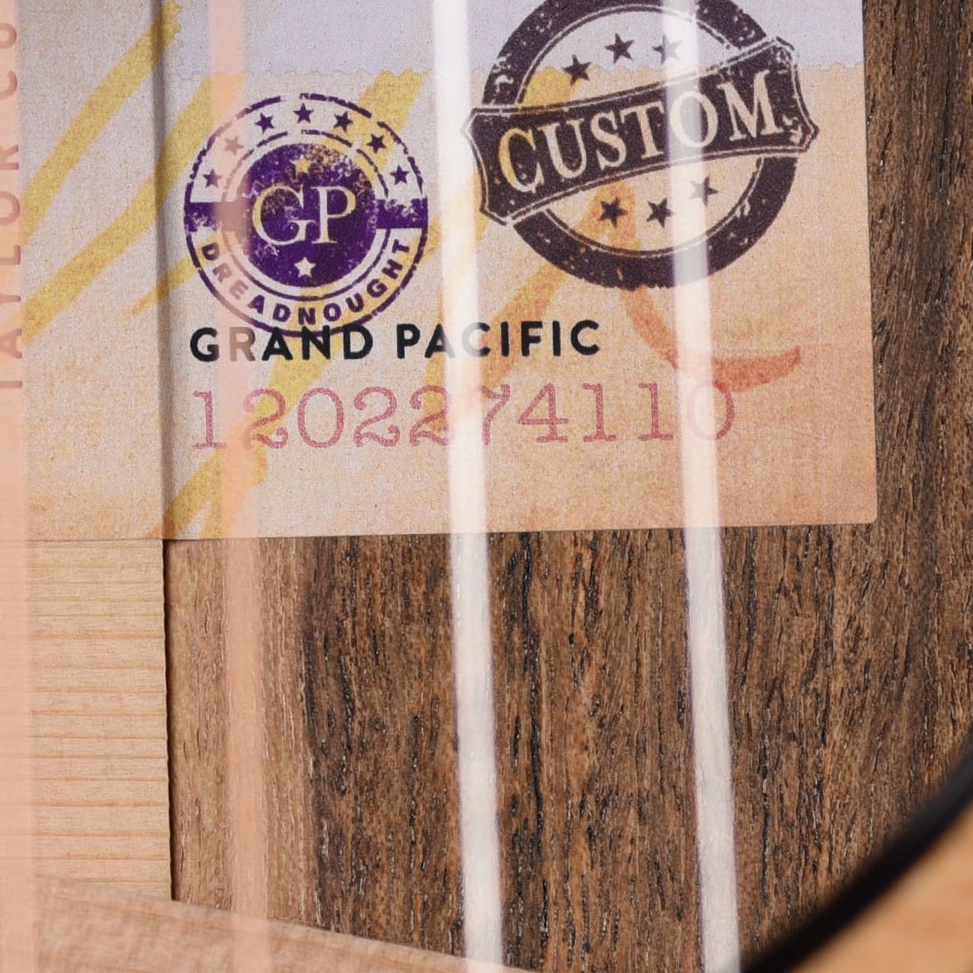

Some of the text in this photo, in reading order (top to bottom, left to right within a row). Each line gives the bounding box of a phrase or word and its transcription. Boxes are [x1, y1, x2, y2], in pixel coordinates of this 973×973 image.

[498, 70, 784, 194] CUSTOM
[251, 183, 357, 247] GP
[201, 238, 411, 326] DREADNOUGHT
[189, 318, 601, 363] GRAND PACIFIC
[191, 380, 736, 450] 1202274110
